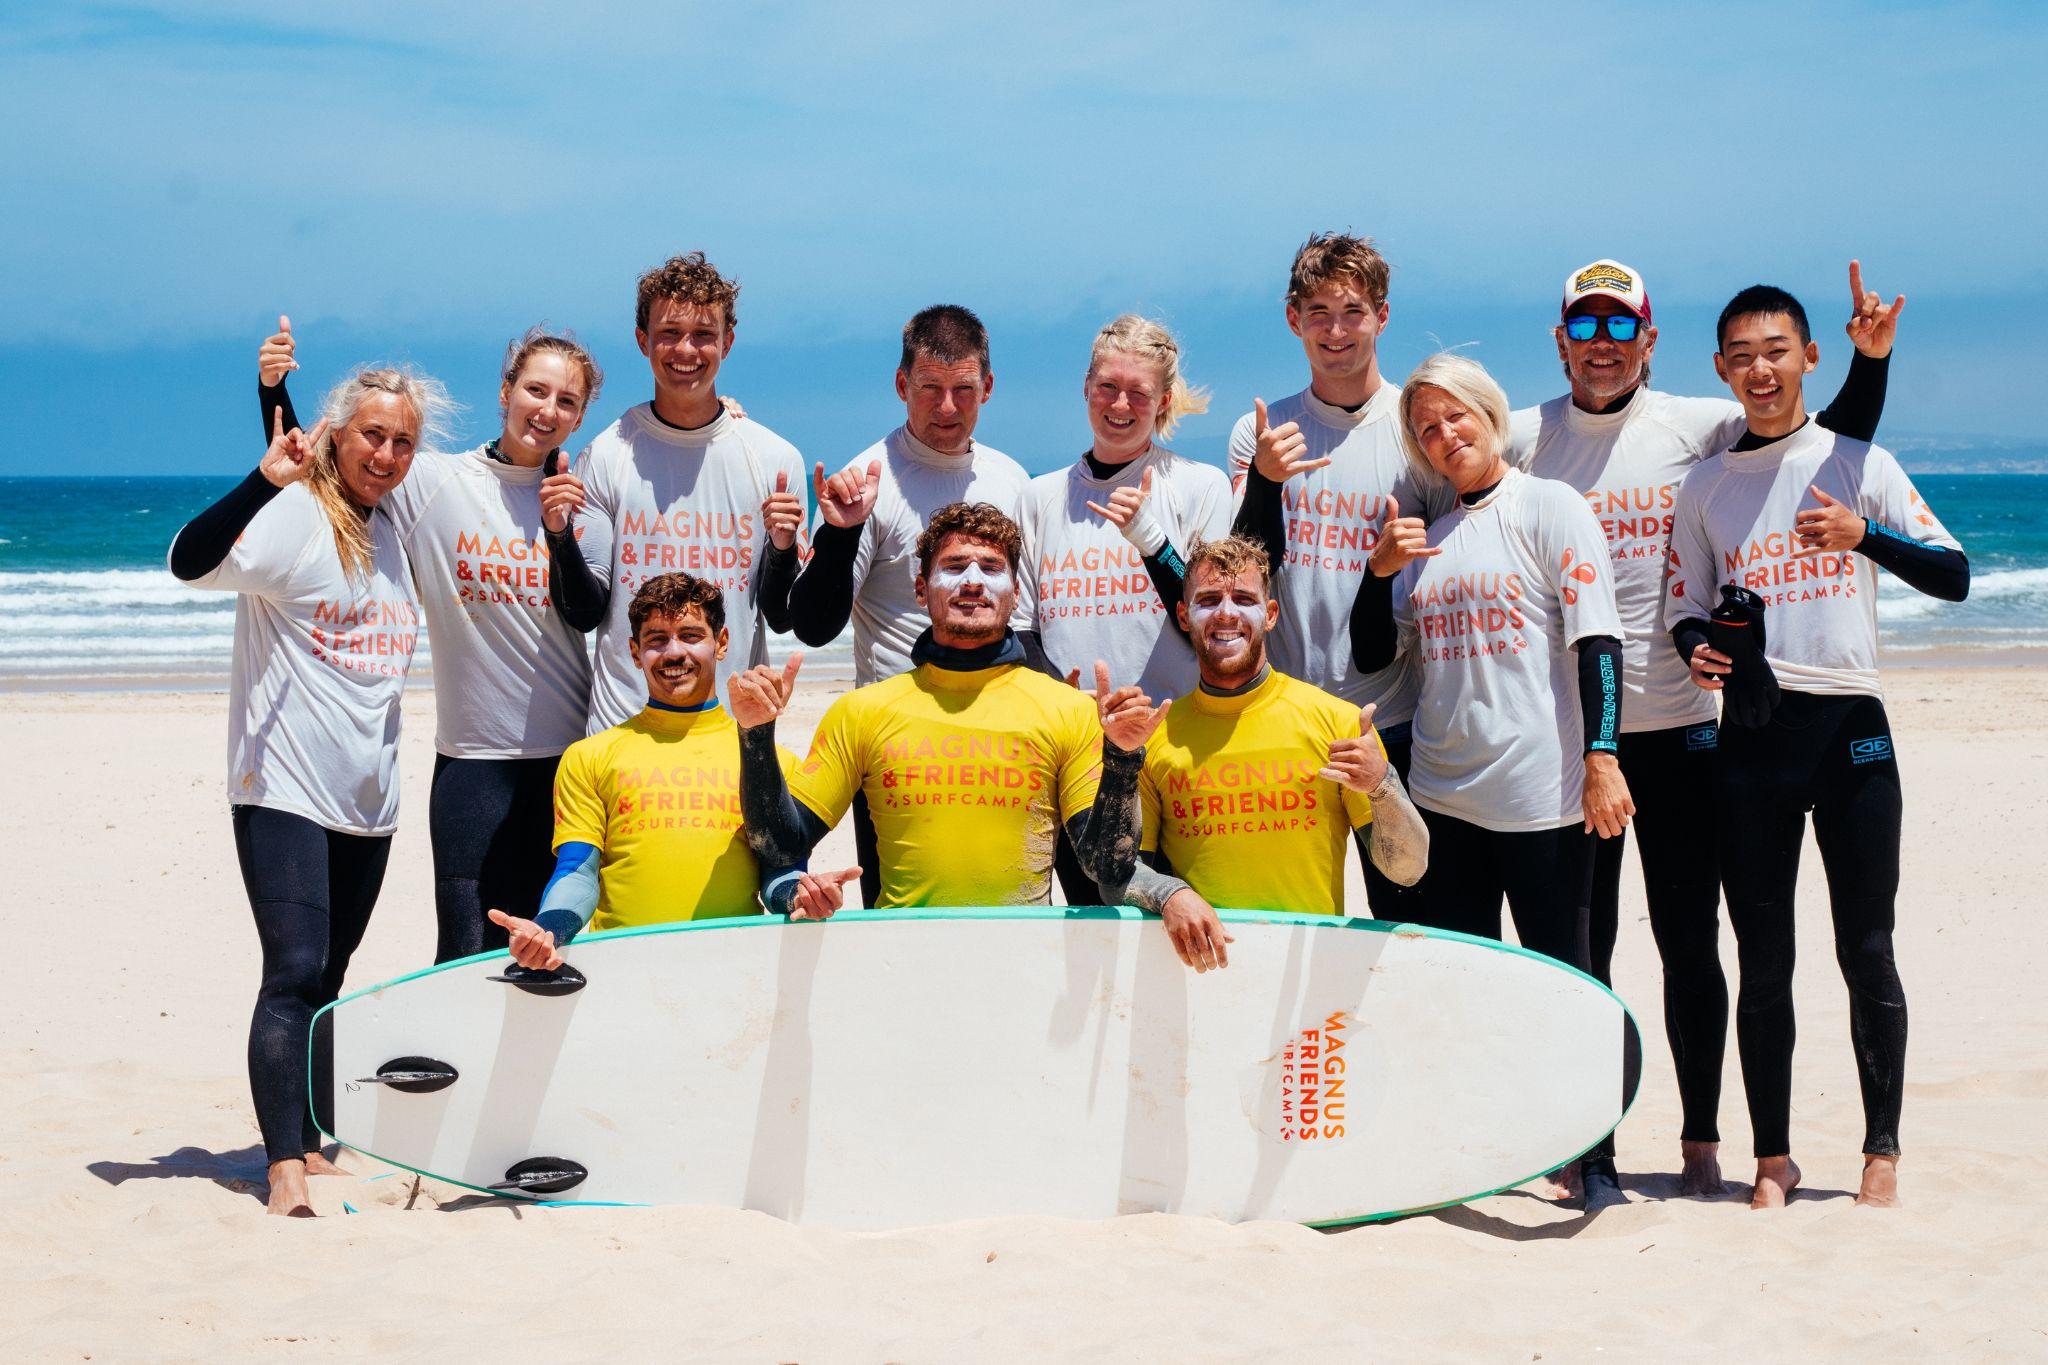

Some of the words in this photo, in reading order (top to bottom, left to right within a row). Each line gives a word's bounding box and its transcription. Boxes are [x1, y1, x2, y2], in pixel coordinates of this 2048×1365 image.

[1584, 486, 1673, 514] GNUS
[623, 510, 753, 540] MAGNUS
[1288, 518, 1380, 550] FRIEND
[456, 560, 473, 581] &
[621, 542, 638, 565] &
[644, 543, 752, 569] FRIENDS
[1039, 546, 1144, 577] MAGNU
[1744, 554, 1855, 590] FRIENDS
[1411, 572, 1521, 612] MAGNUS
[1763, 584, 1841, 607] RFCAMP
[312, 598, 418, 626] MAGNUS
[1049, 601, 1148, 619] SURFCAMP
[1423, 606, 1525, 639] FRIENDS
[1600, 654, 1616, 740] OCEAN+EARTH
[881, 734, 1043, 766] MAGNUS
[616, 767, 741, 792] MAGNU
[905, 765, 1042, 792] FRIENDS
[1168, 759, 1316, 795] MAGNUS
[640, 792, 744, 815] FRIEND
[902, 793, 1022, 809] SURFCAMP
[1172, 799, 1188, 820] &
[1191, 788, 1317, 818] FRIENDS
[1192, 818, 1300, 837] SURFCAMP
[1299, 1029, 1320, 1141] FRIENDS
[1323, 1011, 1347, 1139] MAGNUS
